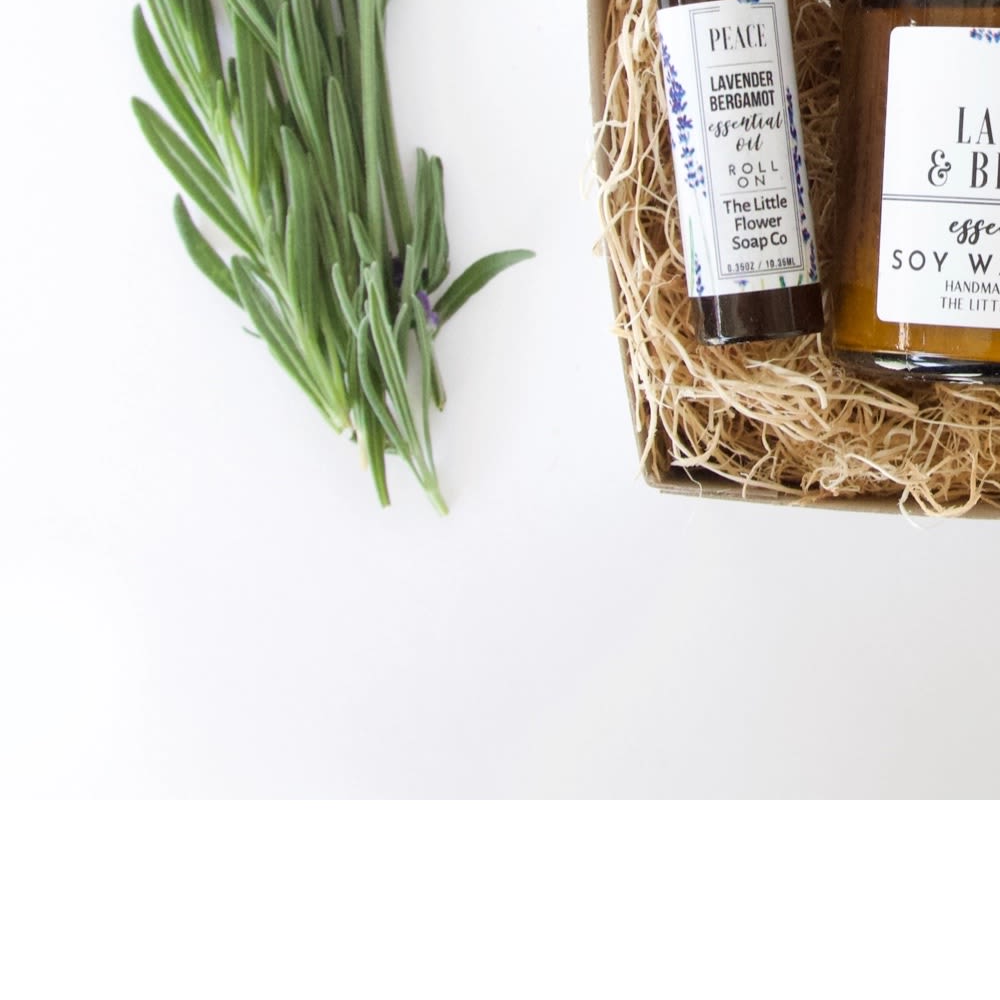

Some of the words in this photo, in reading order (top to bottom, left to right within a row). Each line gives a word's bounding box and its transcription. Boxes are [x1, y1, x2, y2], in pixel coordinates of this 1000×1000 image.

[708, 24, 768, 51] PEACE
[710, 70, 774, 92] LAVENDER
[710, 90, 775, 112] BERGAMOT
[708, 111, 784, 138] essential
[736, 133, 764, 152] oil
[729, 162, 778, 176] ROLL
[927, 149, 952, 187] &
[737, 176, 766, 188] ON
[723, 200, 752, 214] The
[754, 194, 788, 212] Little
[734, 216, 782, 232] Flower
[732, 236, 769, 250] Soap
[770, 232, 788, 246] Co
[892, 249, 949, 272] SOY
[941, 297, 963, 310] THE
